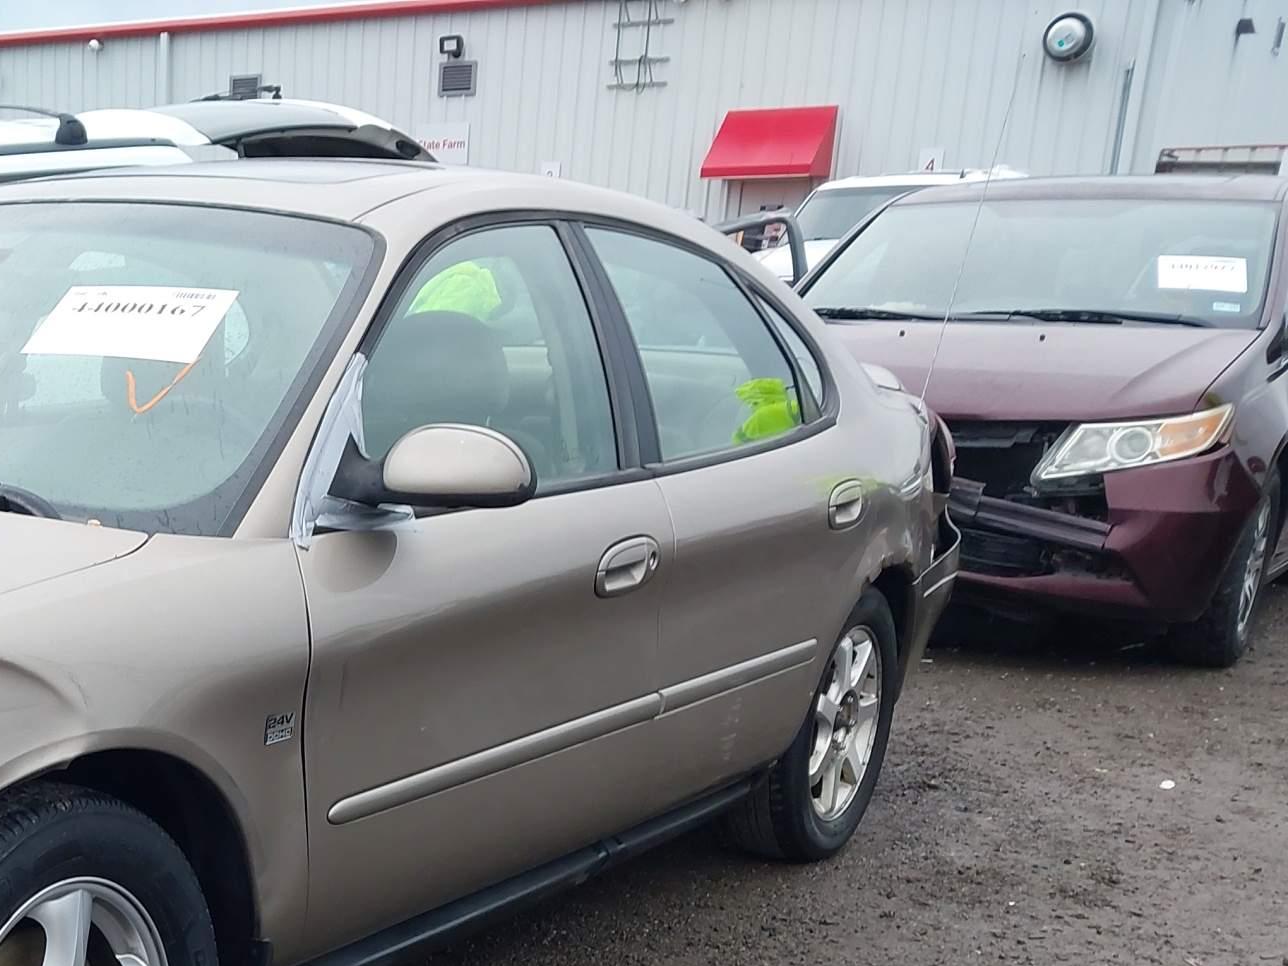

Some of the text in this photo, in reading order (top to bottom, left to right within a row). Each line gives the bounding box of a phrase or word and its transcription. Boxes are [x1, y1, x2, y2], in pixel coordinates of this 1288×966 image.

[442, 139, 465, 149] Farm
[72, 302, 207, 317] 44000167
[268, 712, 294, 729] 24V
